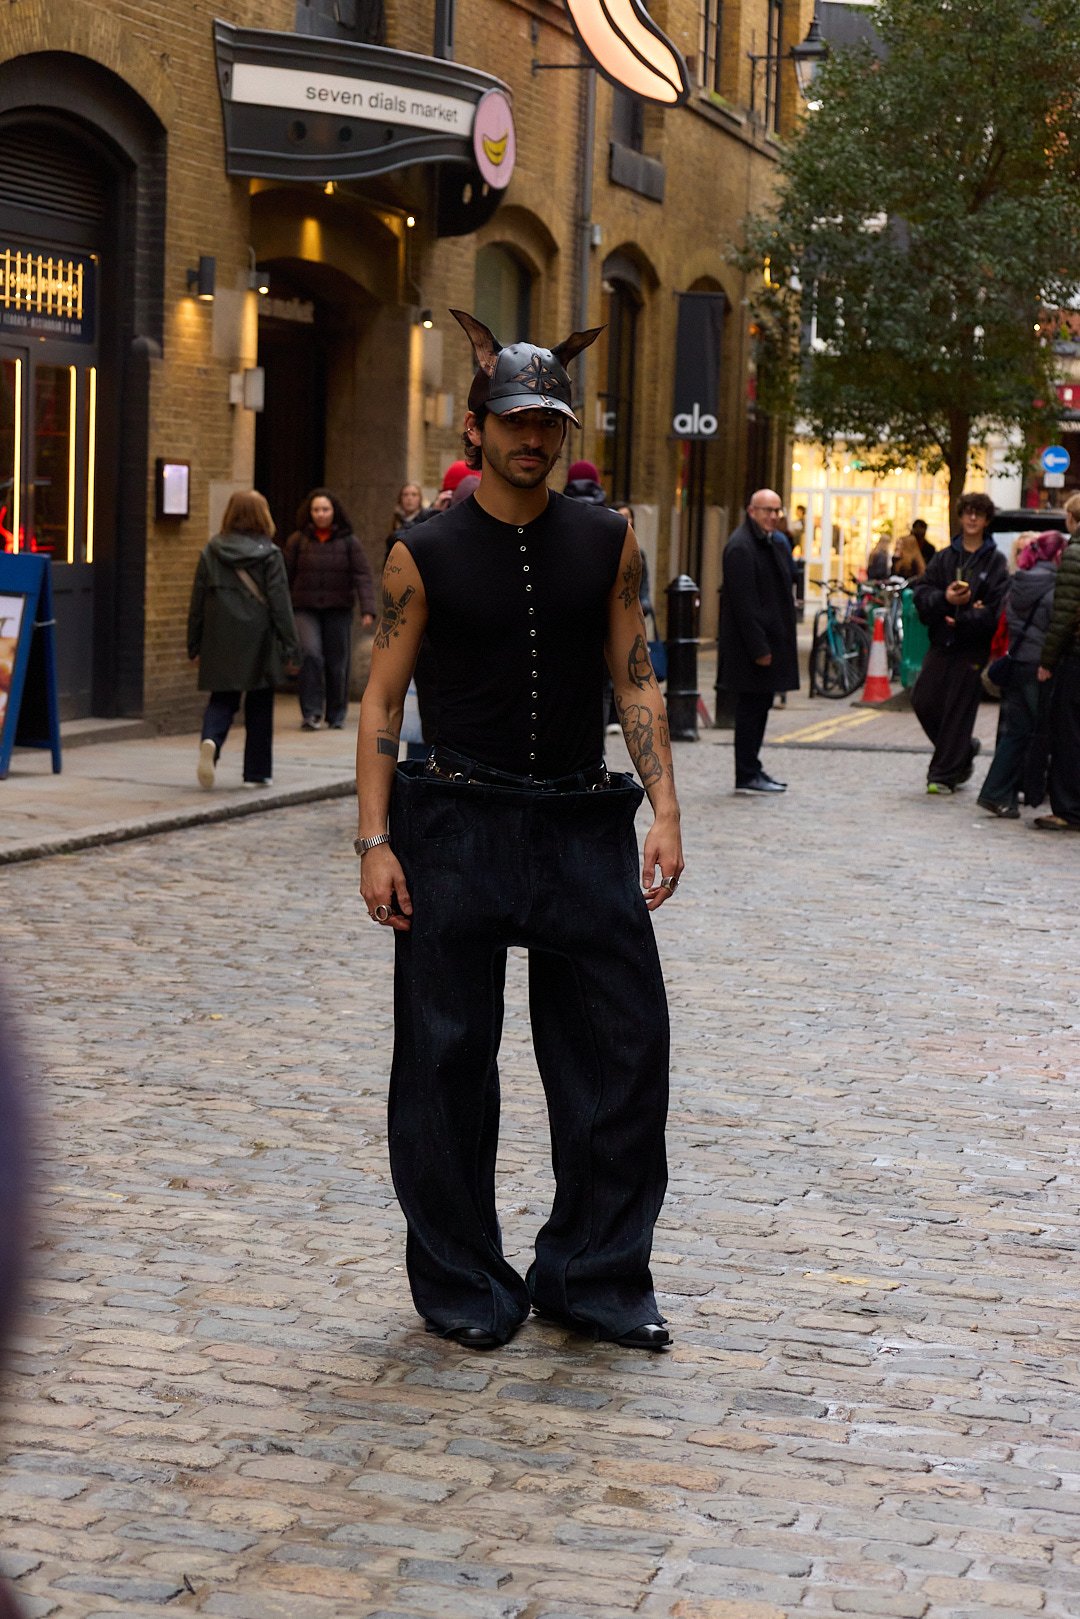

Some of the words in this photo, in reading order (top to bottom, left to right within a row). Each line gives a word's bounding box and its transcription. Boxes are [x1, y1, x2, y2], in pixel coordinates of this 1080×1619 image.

[305, 85, 363, 107] seven
[368, 92, 406, 113] dials
[410, 100, 458, 123] market
[673, 402, 718, 435] alo
